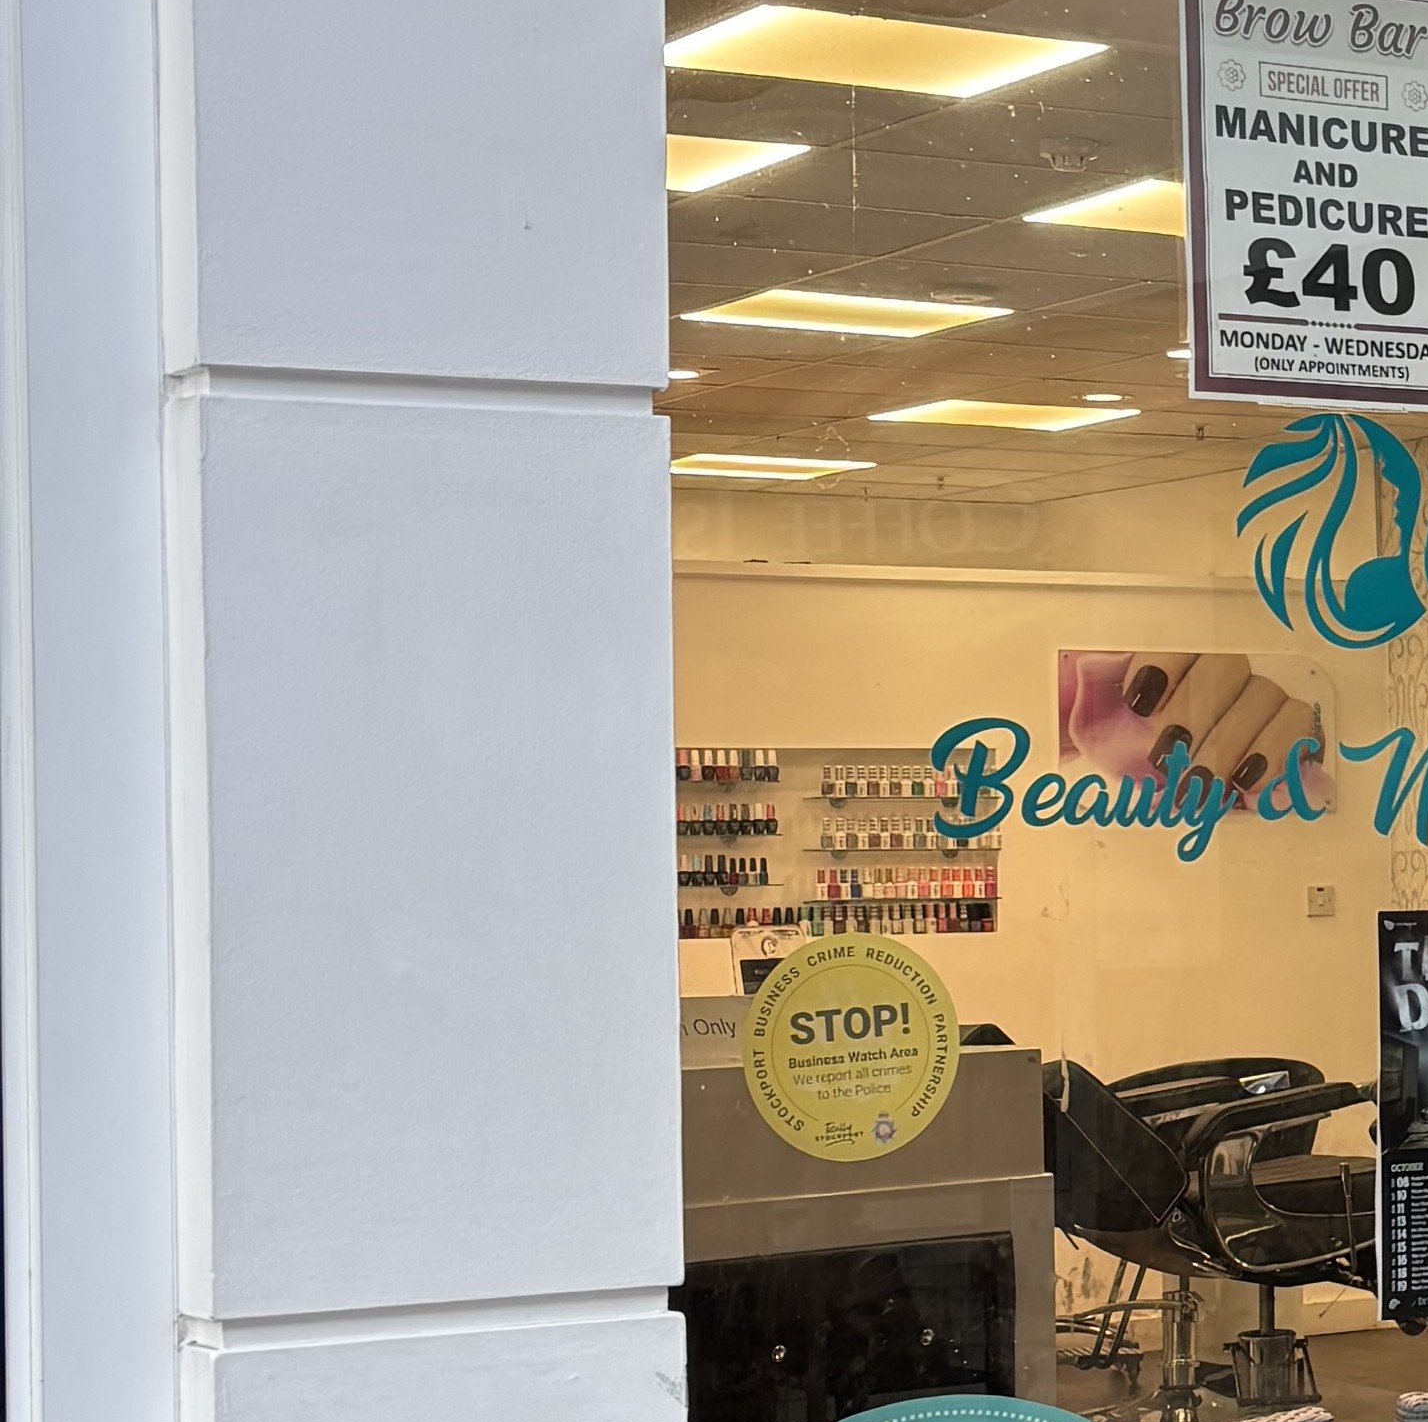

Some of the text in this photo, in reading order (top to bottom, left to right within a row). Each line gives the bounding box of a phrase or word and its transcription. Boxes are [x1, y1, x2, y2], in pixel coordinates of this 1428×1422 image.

[1349, 4, 1428, 60] Bar
[1268, 70, 1380, 104] SPECIAL OFFER
[1293, 161, 1359, 188] AND
[1243, 238, 1417, 316] £40
[1220, 330, 1308, 354] MONDAY
[1254, 356, 1410, 381] (ONLY APPOINTMENTS)
[931, 717, 1238, 862] Beauty
[1258, 737, 1328, 821] &
[693, 1018, 737, 1038] Only
[790, 1002, 911, 1045] STOP!
[753, 945, 948, 1132] STOCKPORT BUSINESS CRIME REDUCTION PARTNERSHIP
[789, 1047, 918, 1069] Business Watch Area
[793, 1065, 912, 1086] We report all crimes
[817, 1088, 830, 1100] to
[832, 1086, 852, 1099] the
